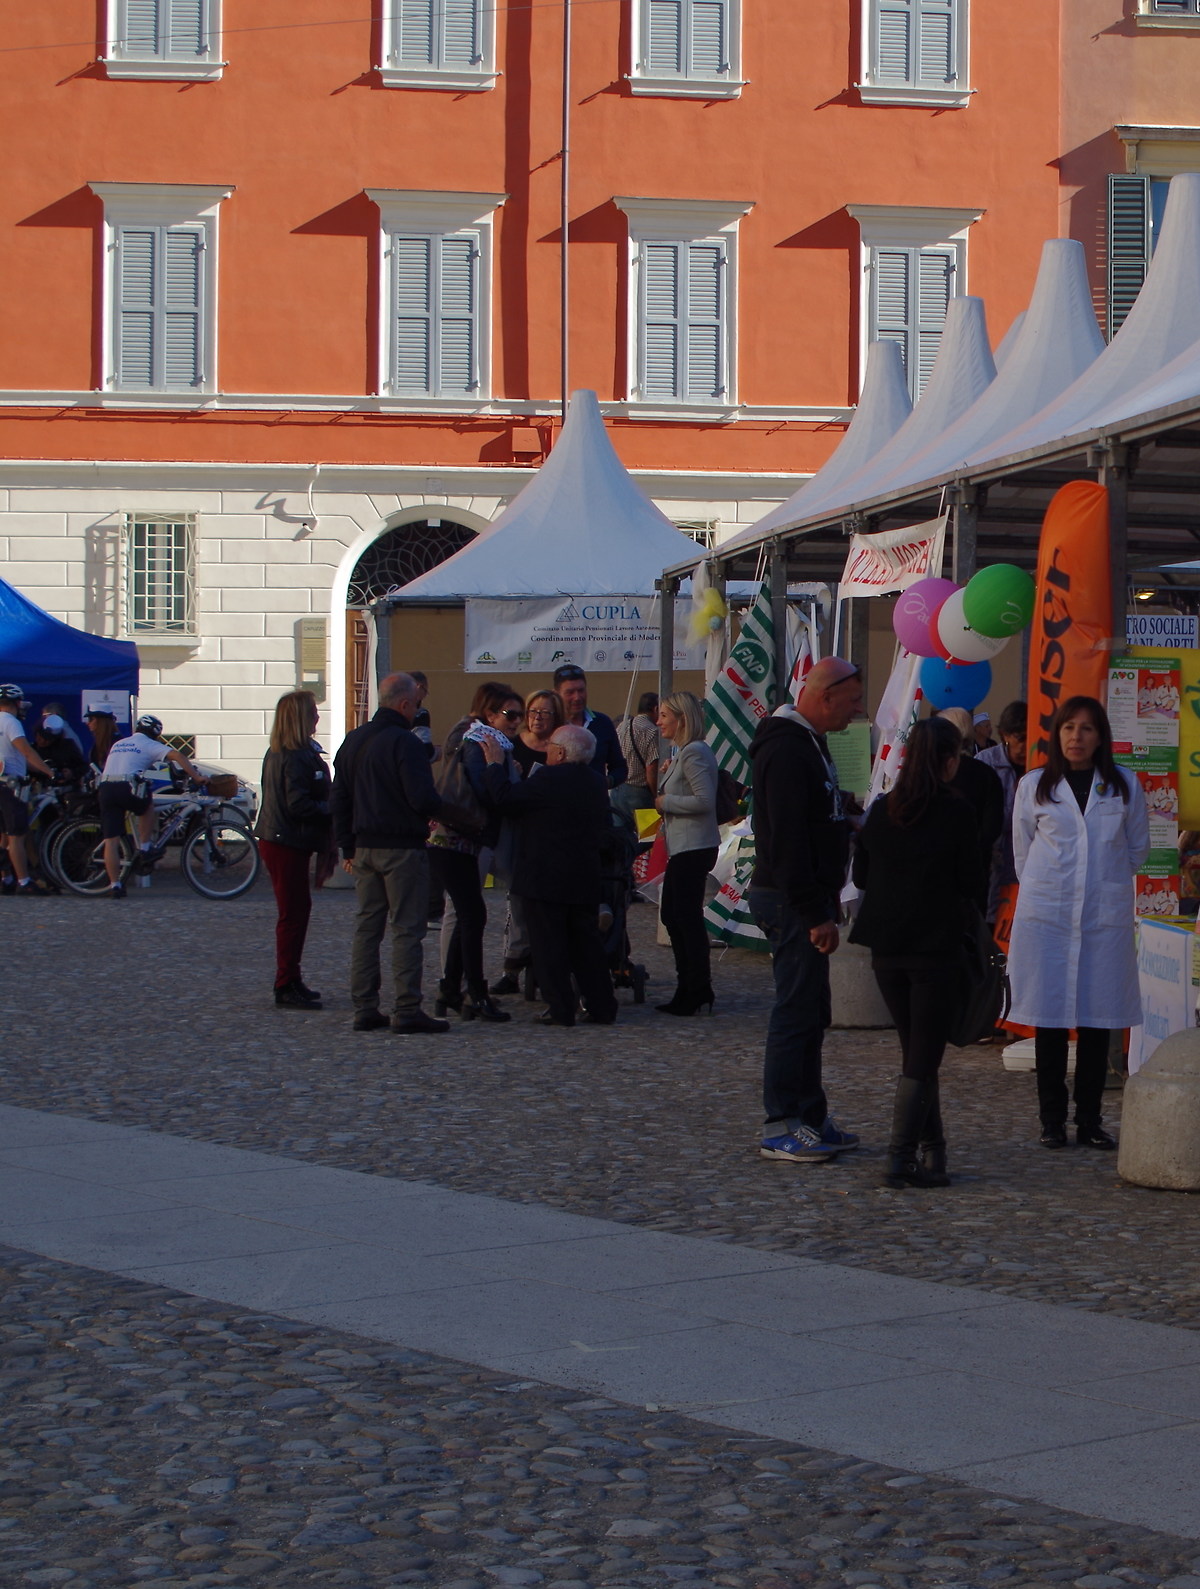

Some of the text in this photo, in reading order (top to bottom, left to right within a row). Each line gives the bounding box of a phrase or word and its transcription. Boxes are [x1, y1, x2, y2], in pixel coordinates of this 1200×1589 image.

[582, 605, 641, 620] CUPLA
[1149, 617, 1195, 635] SOCIALE
[530, 634, 586, 643] Coordinamento
[588, 634, 628, 642] Provinciale
[736, 646, 765, 675] FNP
